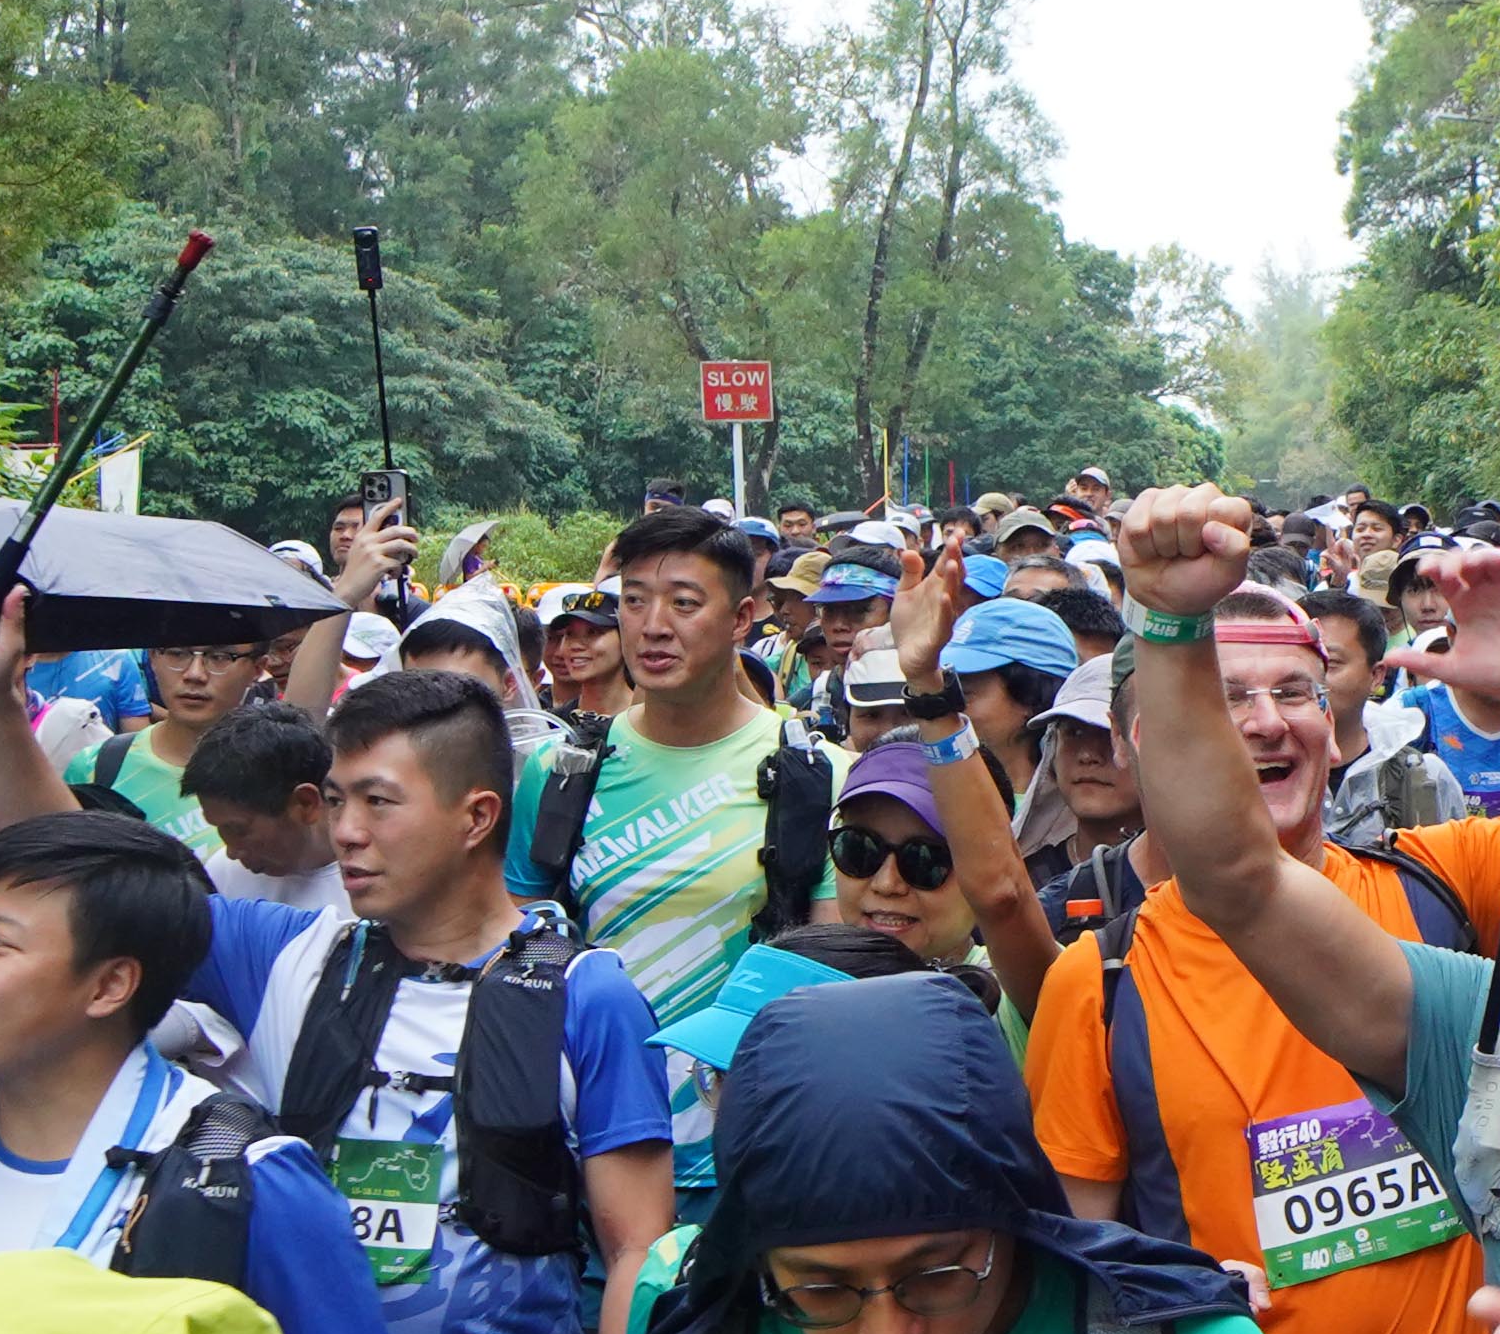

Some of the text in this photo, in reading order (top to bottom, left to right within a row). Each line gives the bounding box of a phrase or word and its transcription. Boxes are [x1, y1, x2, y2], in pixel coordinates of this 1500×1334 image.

[707, 371, 765, 386] SLOW
[569, 772, 739, 891] AILWALKER
[351, 1205, 405, 1244] 8A
[1284, 1159, 1440, 1235] 0965A
